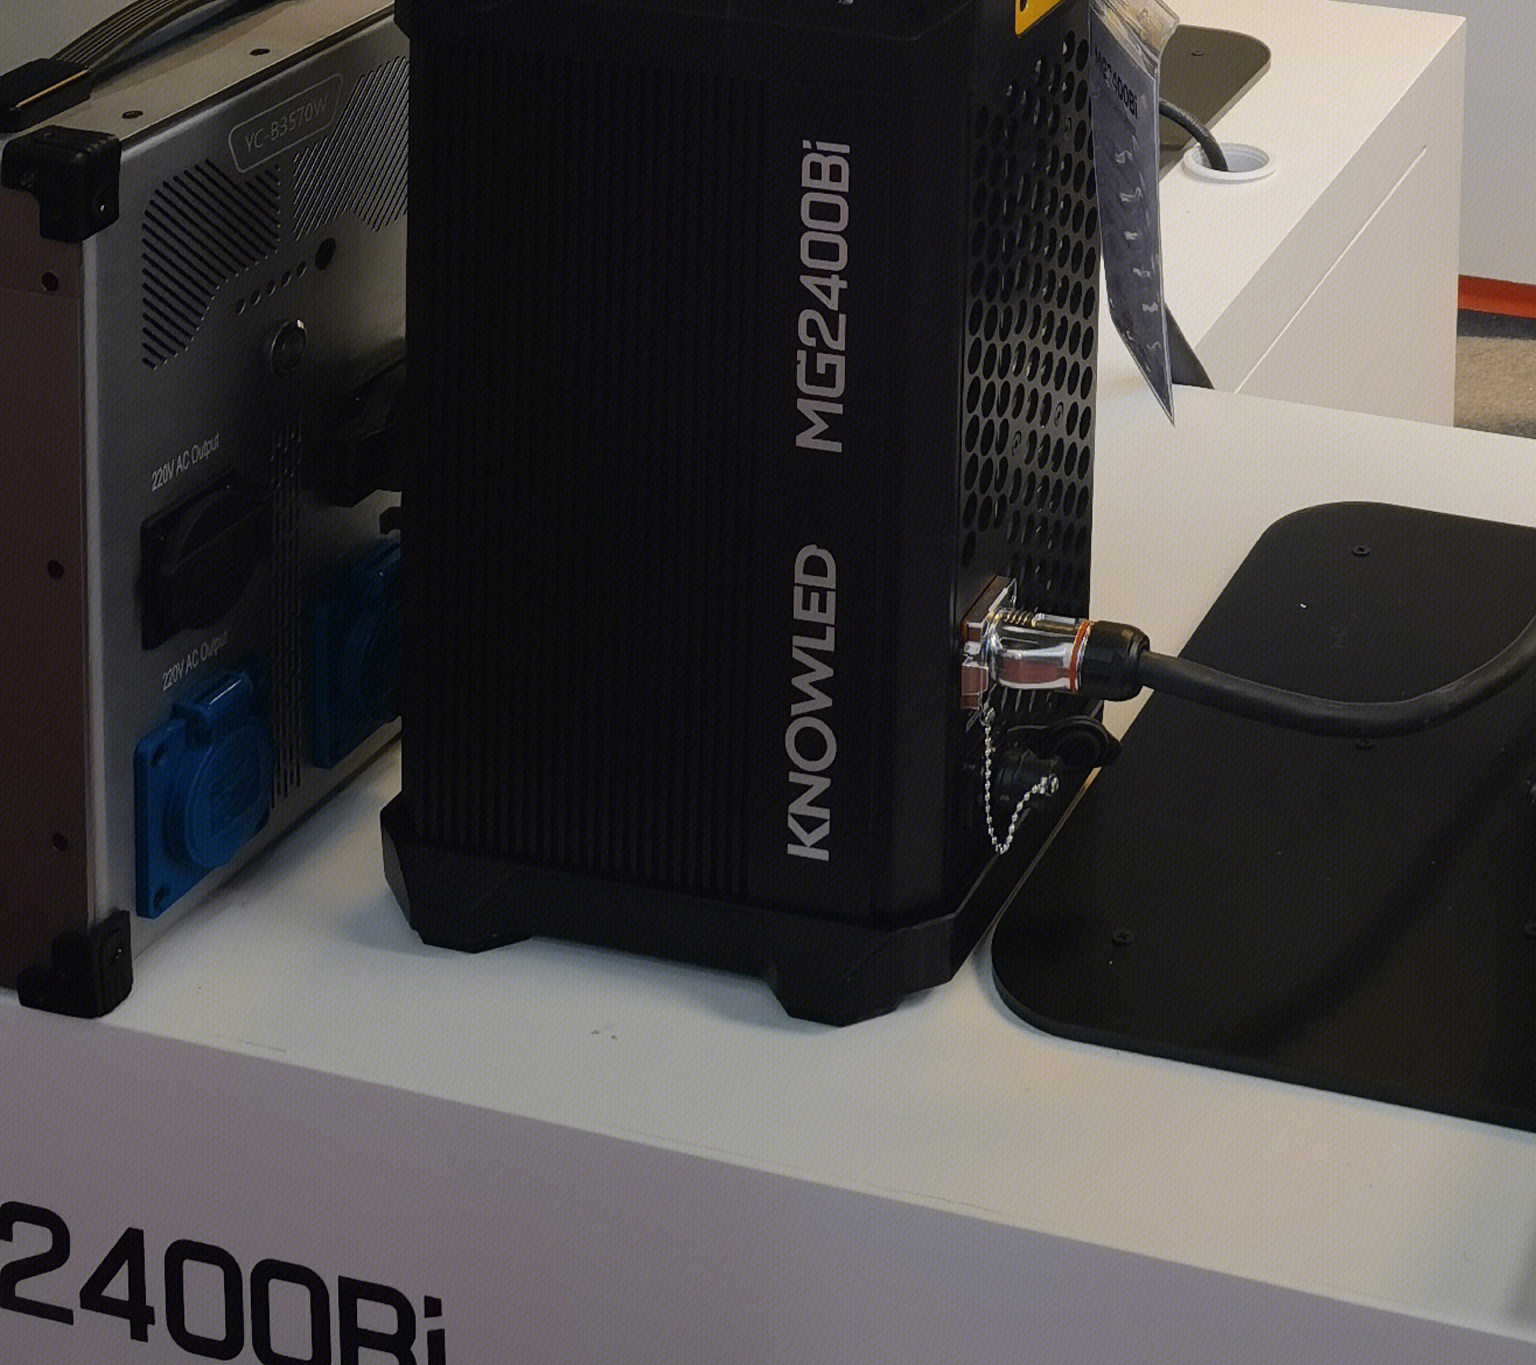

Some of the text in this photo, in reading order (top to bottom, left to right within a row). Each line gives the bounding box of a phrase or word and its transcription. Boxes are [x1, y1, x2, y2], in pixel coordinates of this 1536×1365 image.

[245, 93, 328, 153] YC-B3570W
[795, 138, 852, 453] MG2400Bi
[151, 432, 220, 493] 220V AC Output
[162, 658, 185, 692] 220V
[185, 649, 199, 676] AC
[784, 543, 838, 862] KNOWLED
